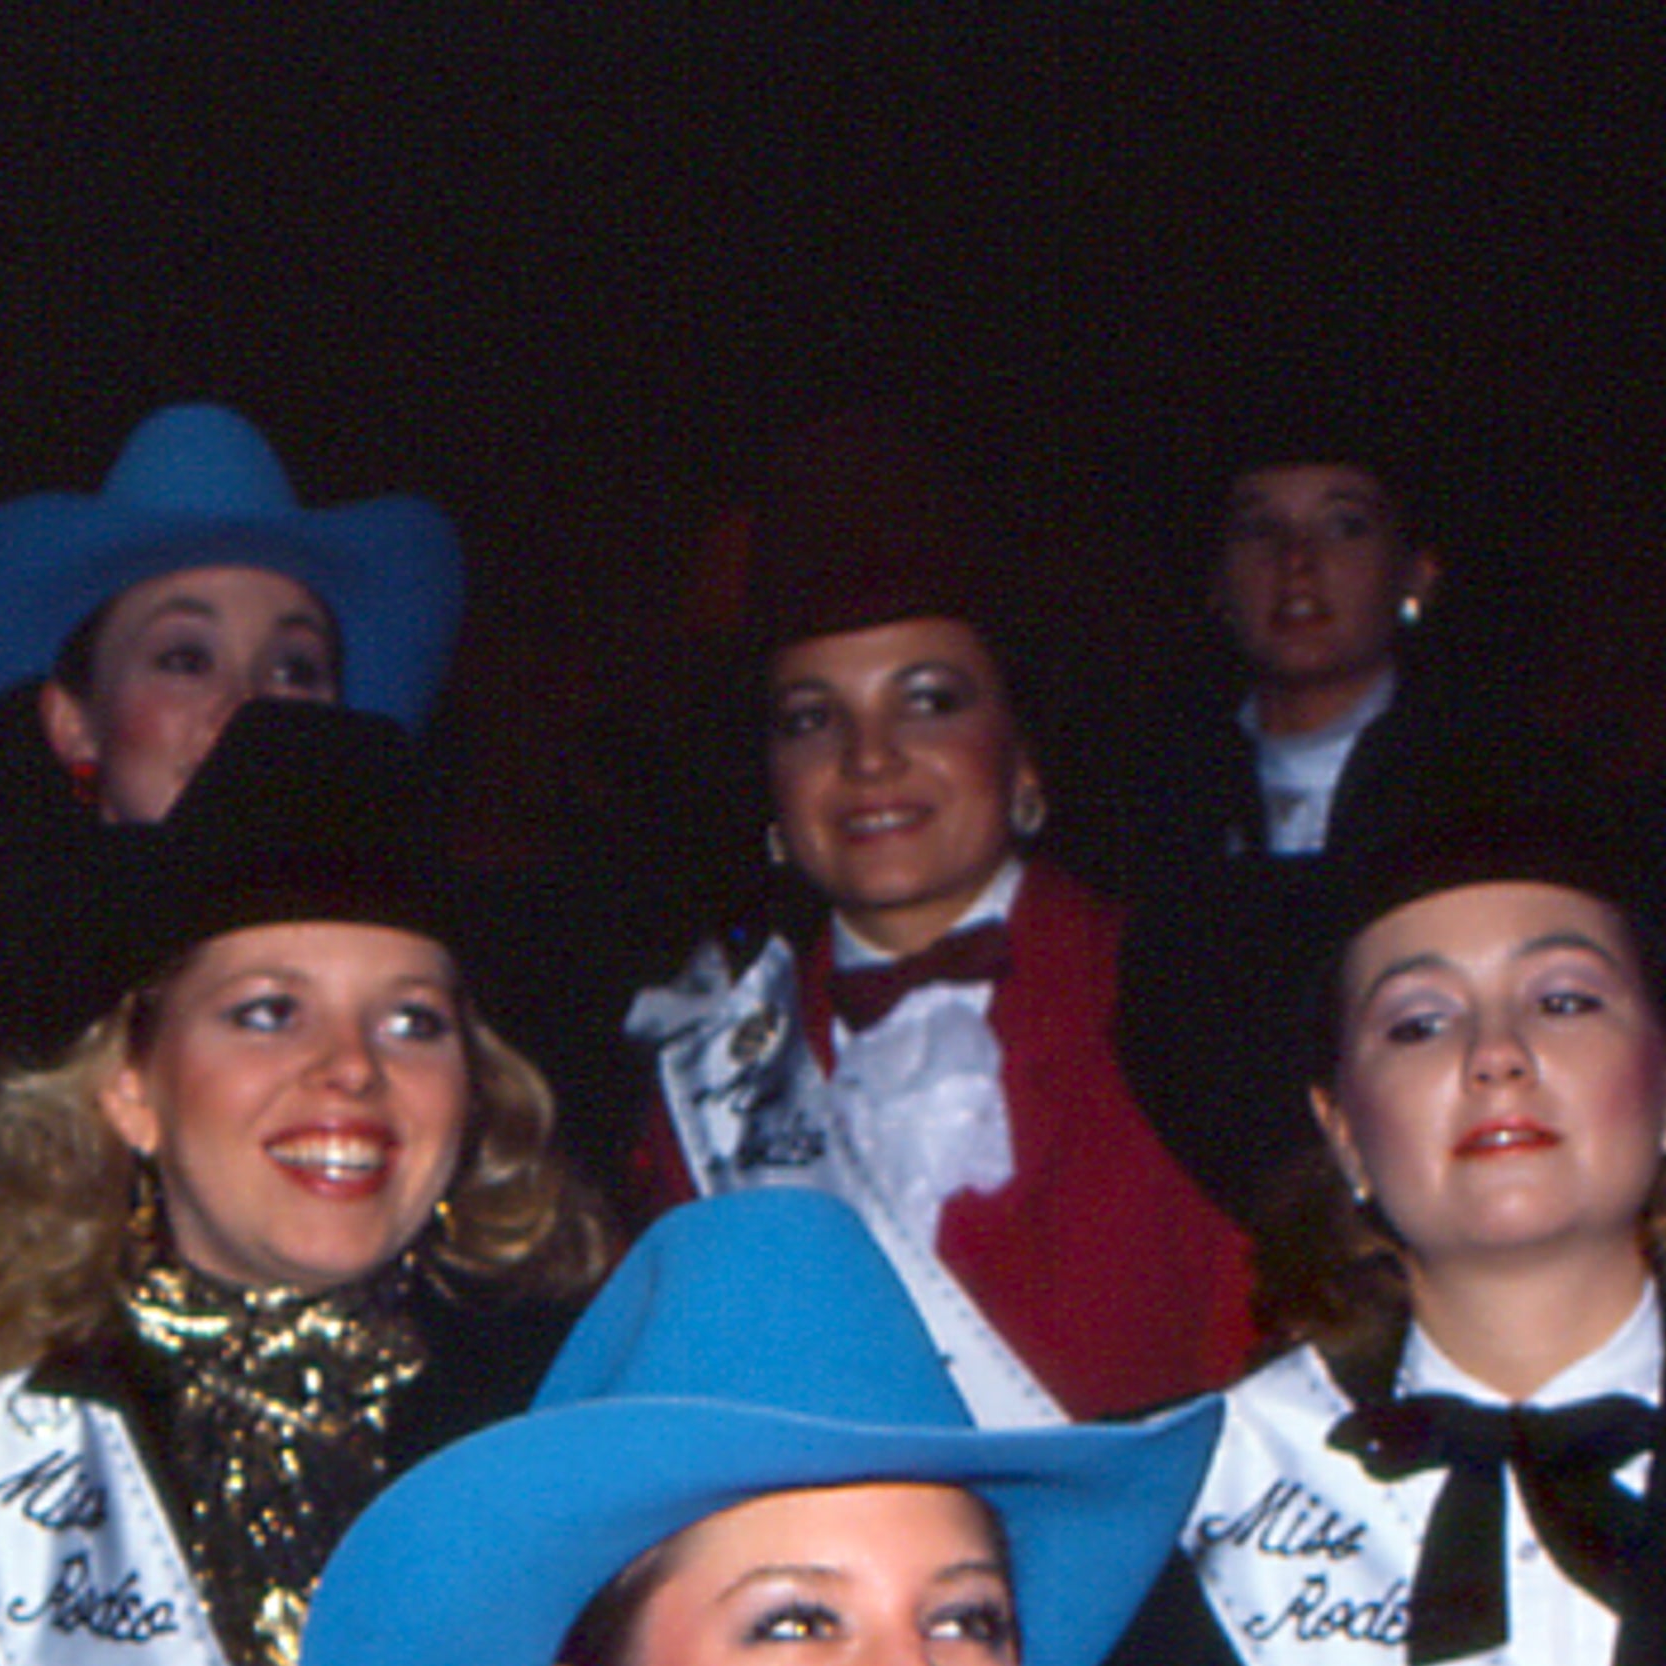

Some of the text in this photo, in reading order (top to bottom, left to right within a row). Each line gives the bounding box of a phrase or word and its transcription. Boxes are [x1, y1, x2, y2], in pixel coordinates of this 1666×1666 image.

[1197, 1479, 1369, 1563] Miss
[6, 1551, 181, 1643] Rodeo
[1243, 1572, 1411, 1646] Rode
